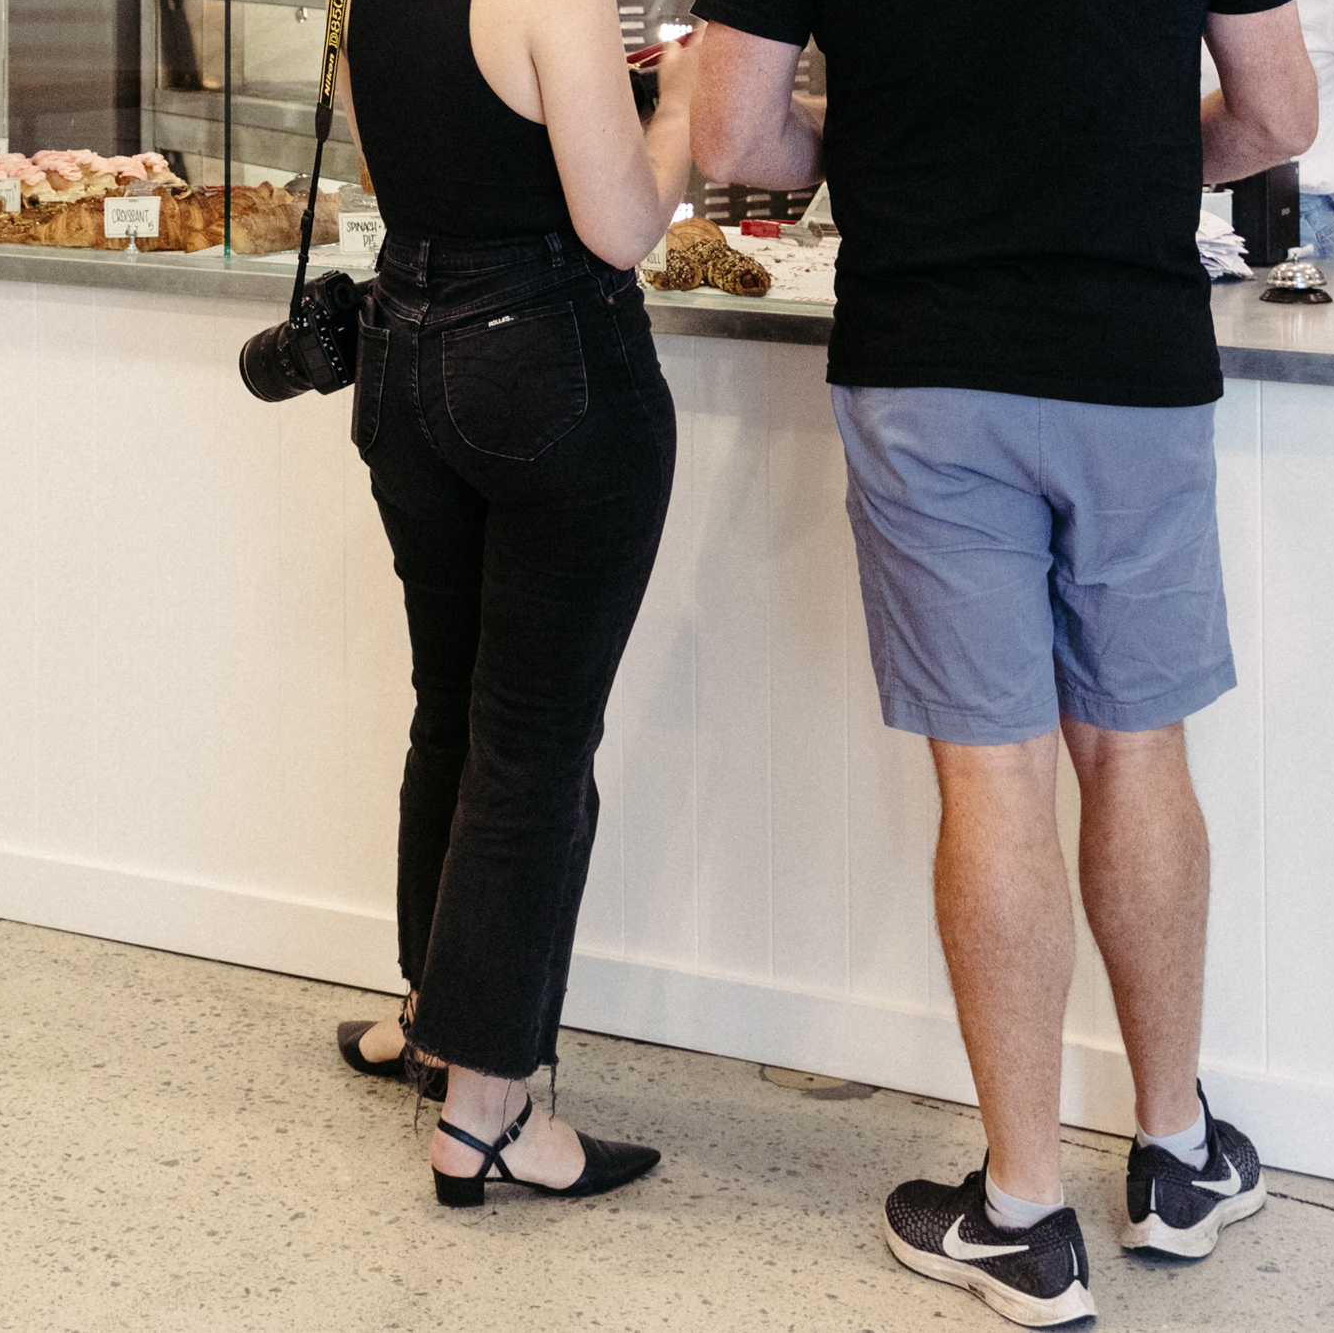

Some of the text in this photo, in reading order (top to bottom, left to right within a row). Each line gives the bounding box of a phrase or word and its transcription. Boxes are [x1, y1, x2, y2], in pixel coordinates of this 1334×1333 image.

[324, 53, 334, 96] Nikon
[111, 209, 150, 224] CROISSANT
[346, 221, 378, 233] SPINACH
